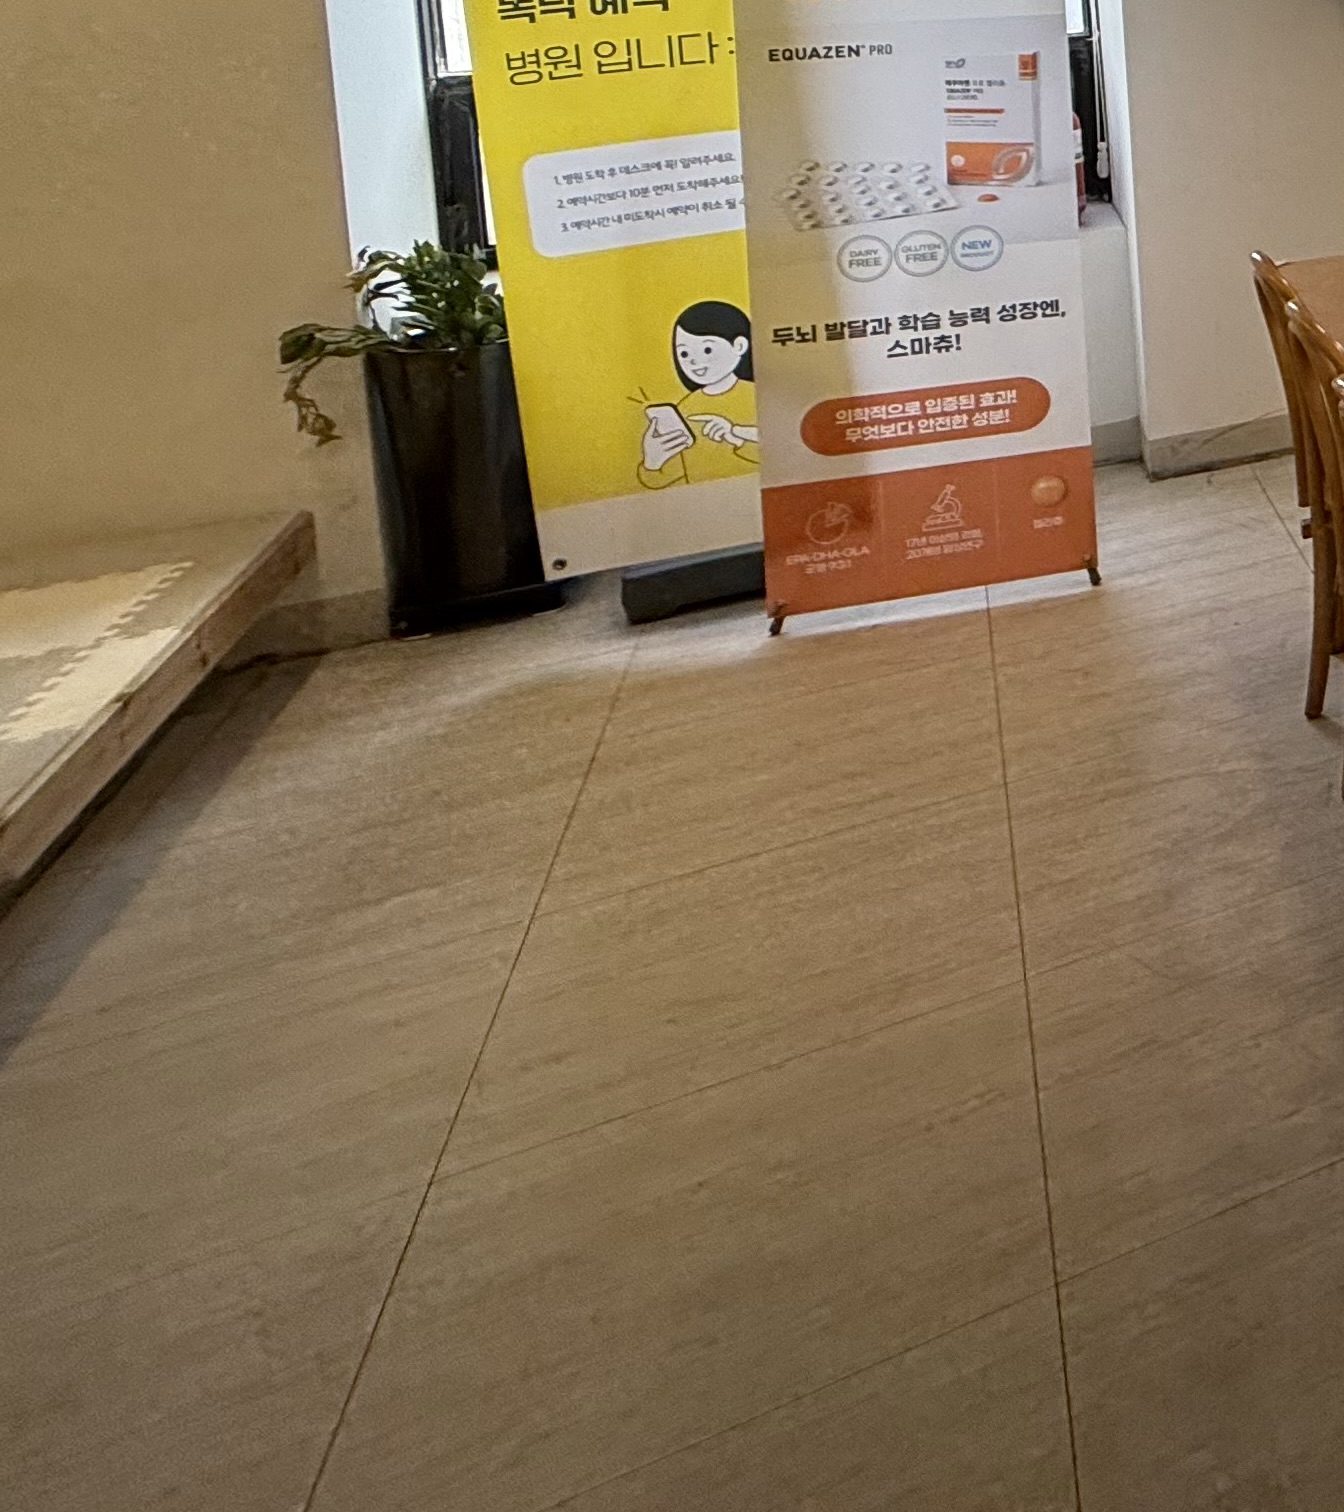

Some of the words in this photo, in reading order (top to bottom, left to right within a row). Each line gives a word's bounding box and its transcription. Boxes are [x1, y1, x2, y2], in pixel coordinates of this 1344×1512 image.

[869, 44, 893, 56] PRO
[505, 44, 583, 86] 병원
[563, 172, 583, 185] 병원
[585, 170, 605, 180] 도착
[607, 167, 618, 177] 후
[619, 160, 662, 175] 데스크에
[567, 190, 627, 206] 예약시간보다
[629, 187, 650, 198] 10분
[652, 184, 674, 196] 먼저
[570, 217, 610, 230] 예약시간
[612, 214, 623, 225] 내
[667, 203, 699, 216] 예약이
[702, 201, 724, 213] 취소
[850, 248, 879, 258] DAIRY
[902, 243, 941, 253] GLUTEN
[961, 239, 992, 250] NEW
[848, 256, 882, 269] FREE
[905, 251, 938, 264] FREE
[771, 325, 817, 346] 두뇌
[824, 317, 892, 341] 발달과
[898, 312, 941, 333] 학습
[948, 306, 991, 328] 능력
[996, 299, 1067, 323] 성장엔,
[835, 401, 922, 425] 의학적으로
[925, 394, 975, 414] 입증된
[979, 389, 1017, 407] 효과!
[845, 422, 914, 443] 무엇보다
[917, 415, 968, 434] 안전한
[971, 409, 1010, 428] 성분!
